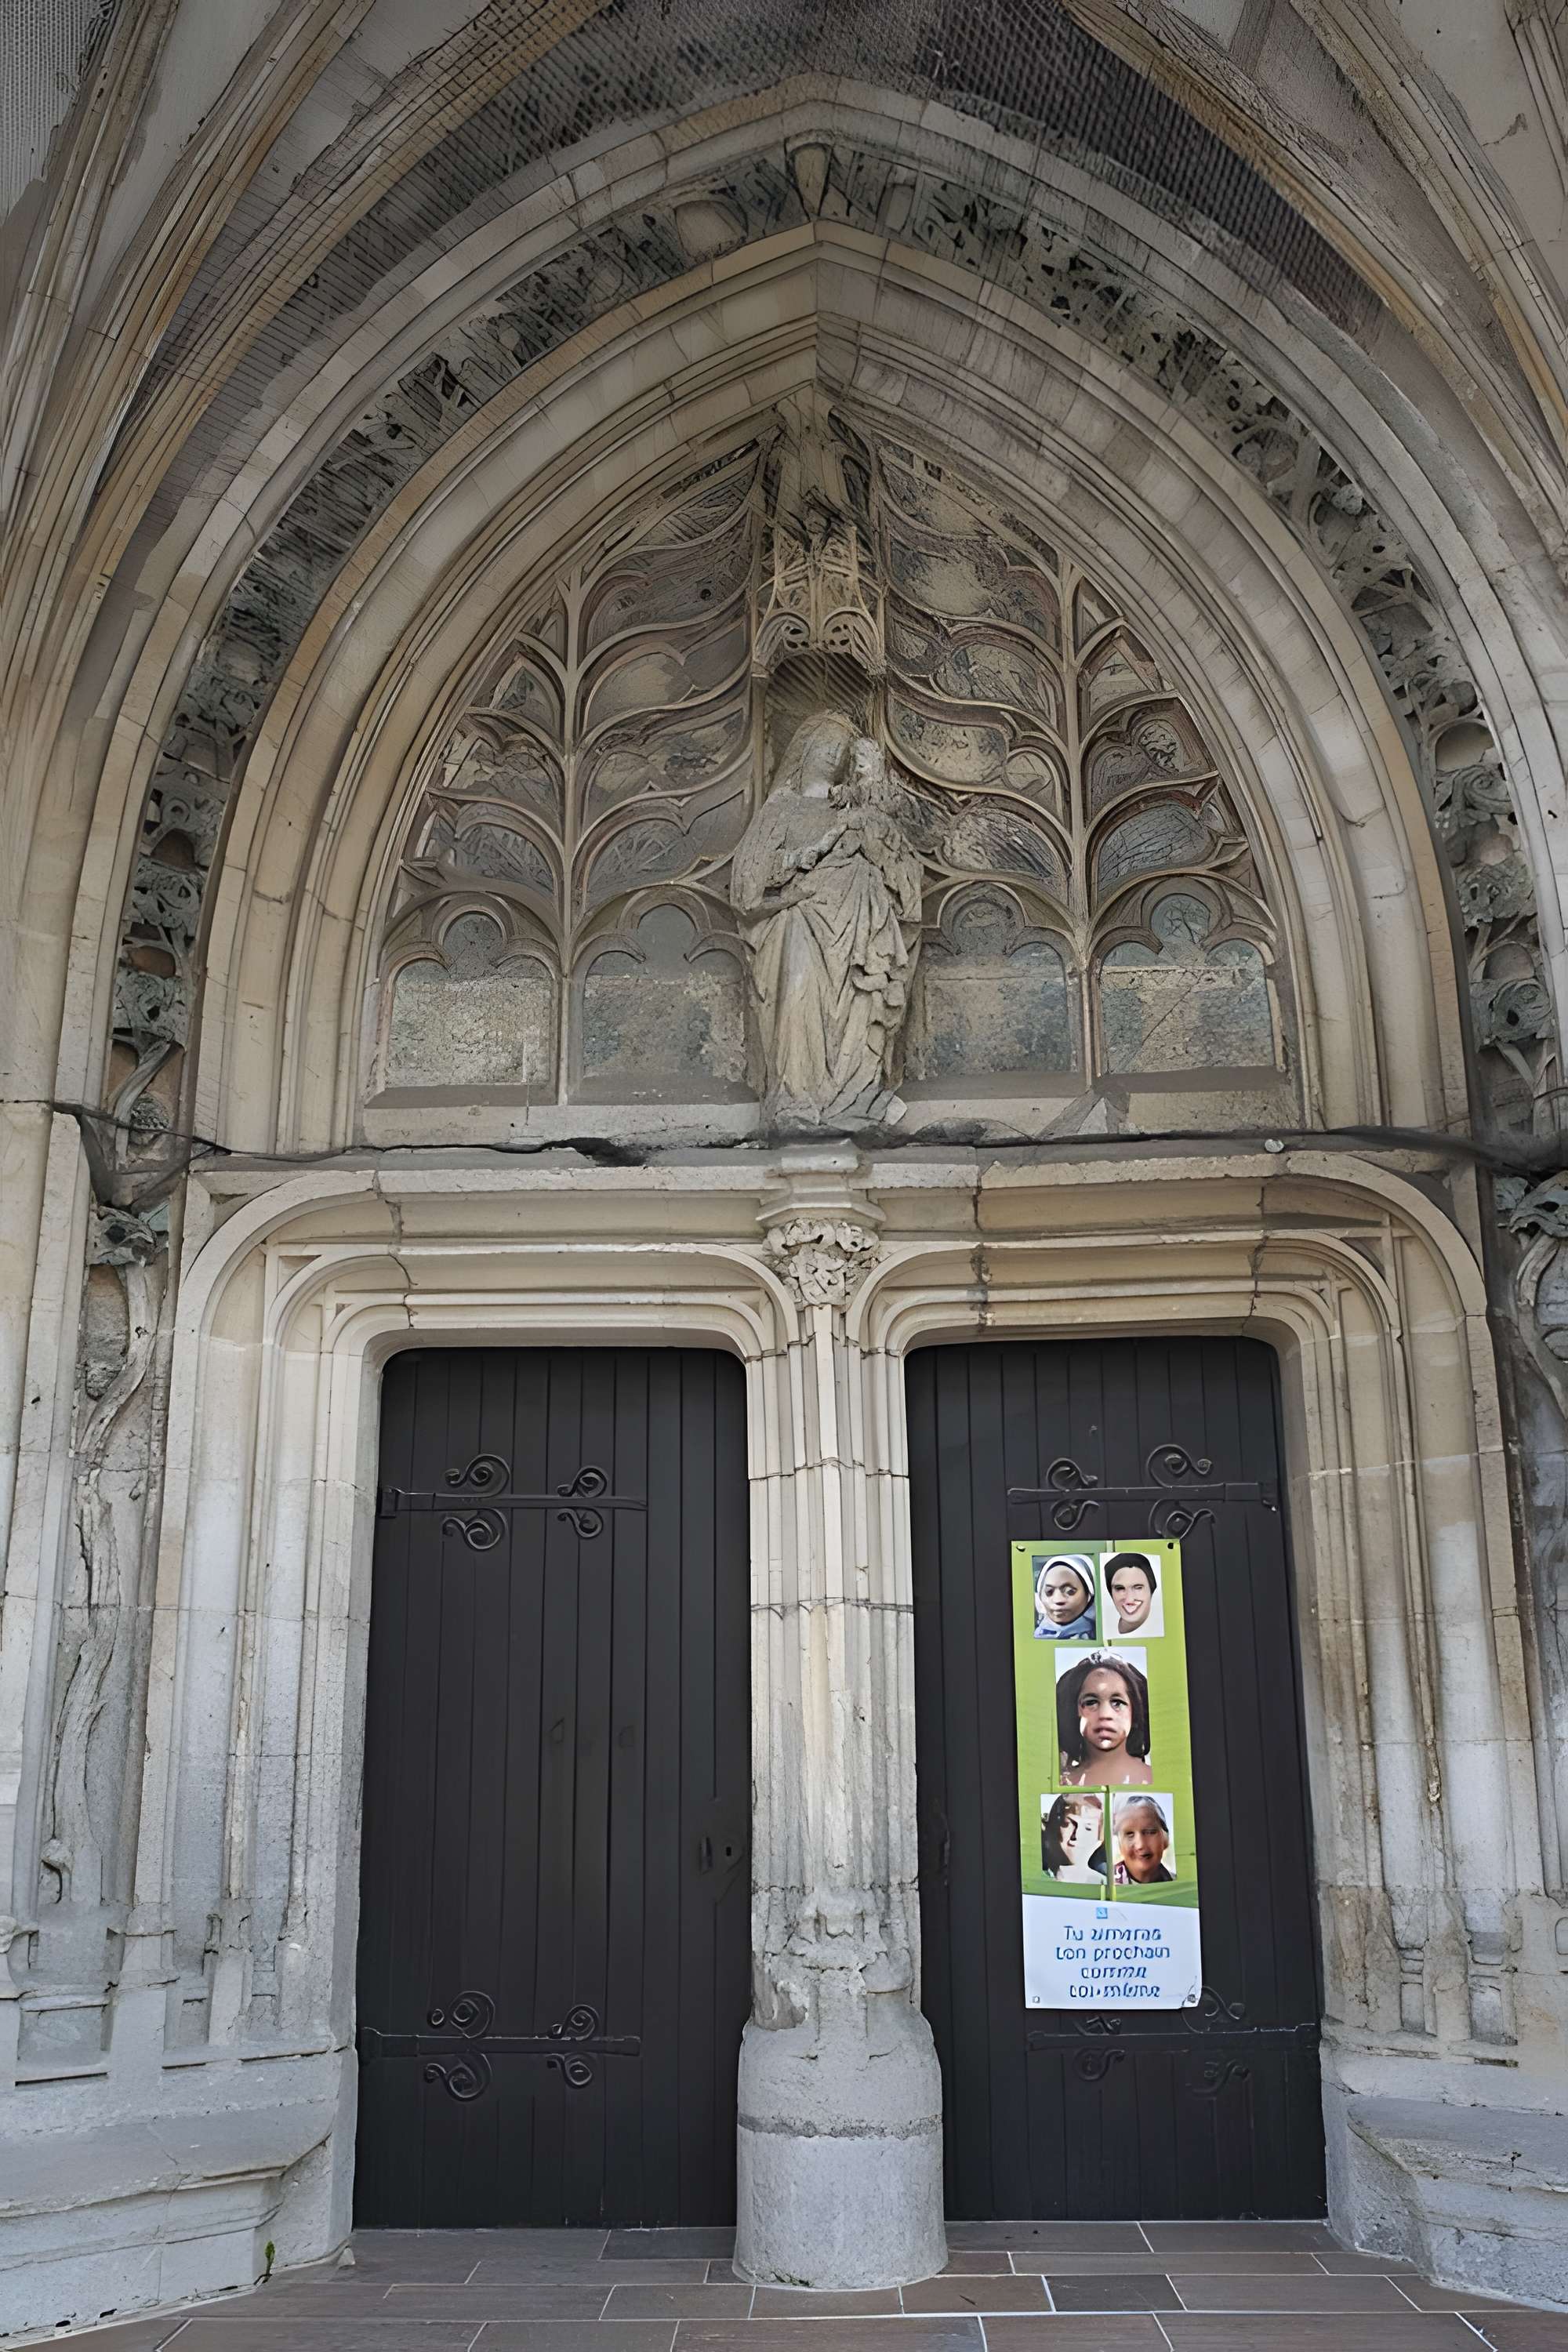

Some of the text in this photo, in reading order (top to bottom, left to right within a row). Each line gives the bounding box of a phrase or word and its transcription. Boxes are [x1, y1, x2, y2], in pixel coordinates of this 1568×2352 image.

[1064, 1926, 1083, 1940] Tu
[1056, 1946, 1171, 1962] ton prochain
